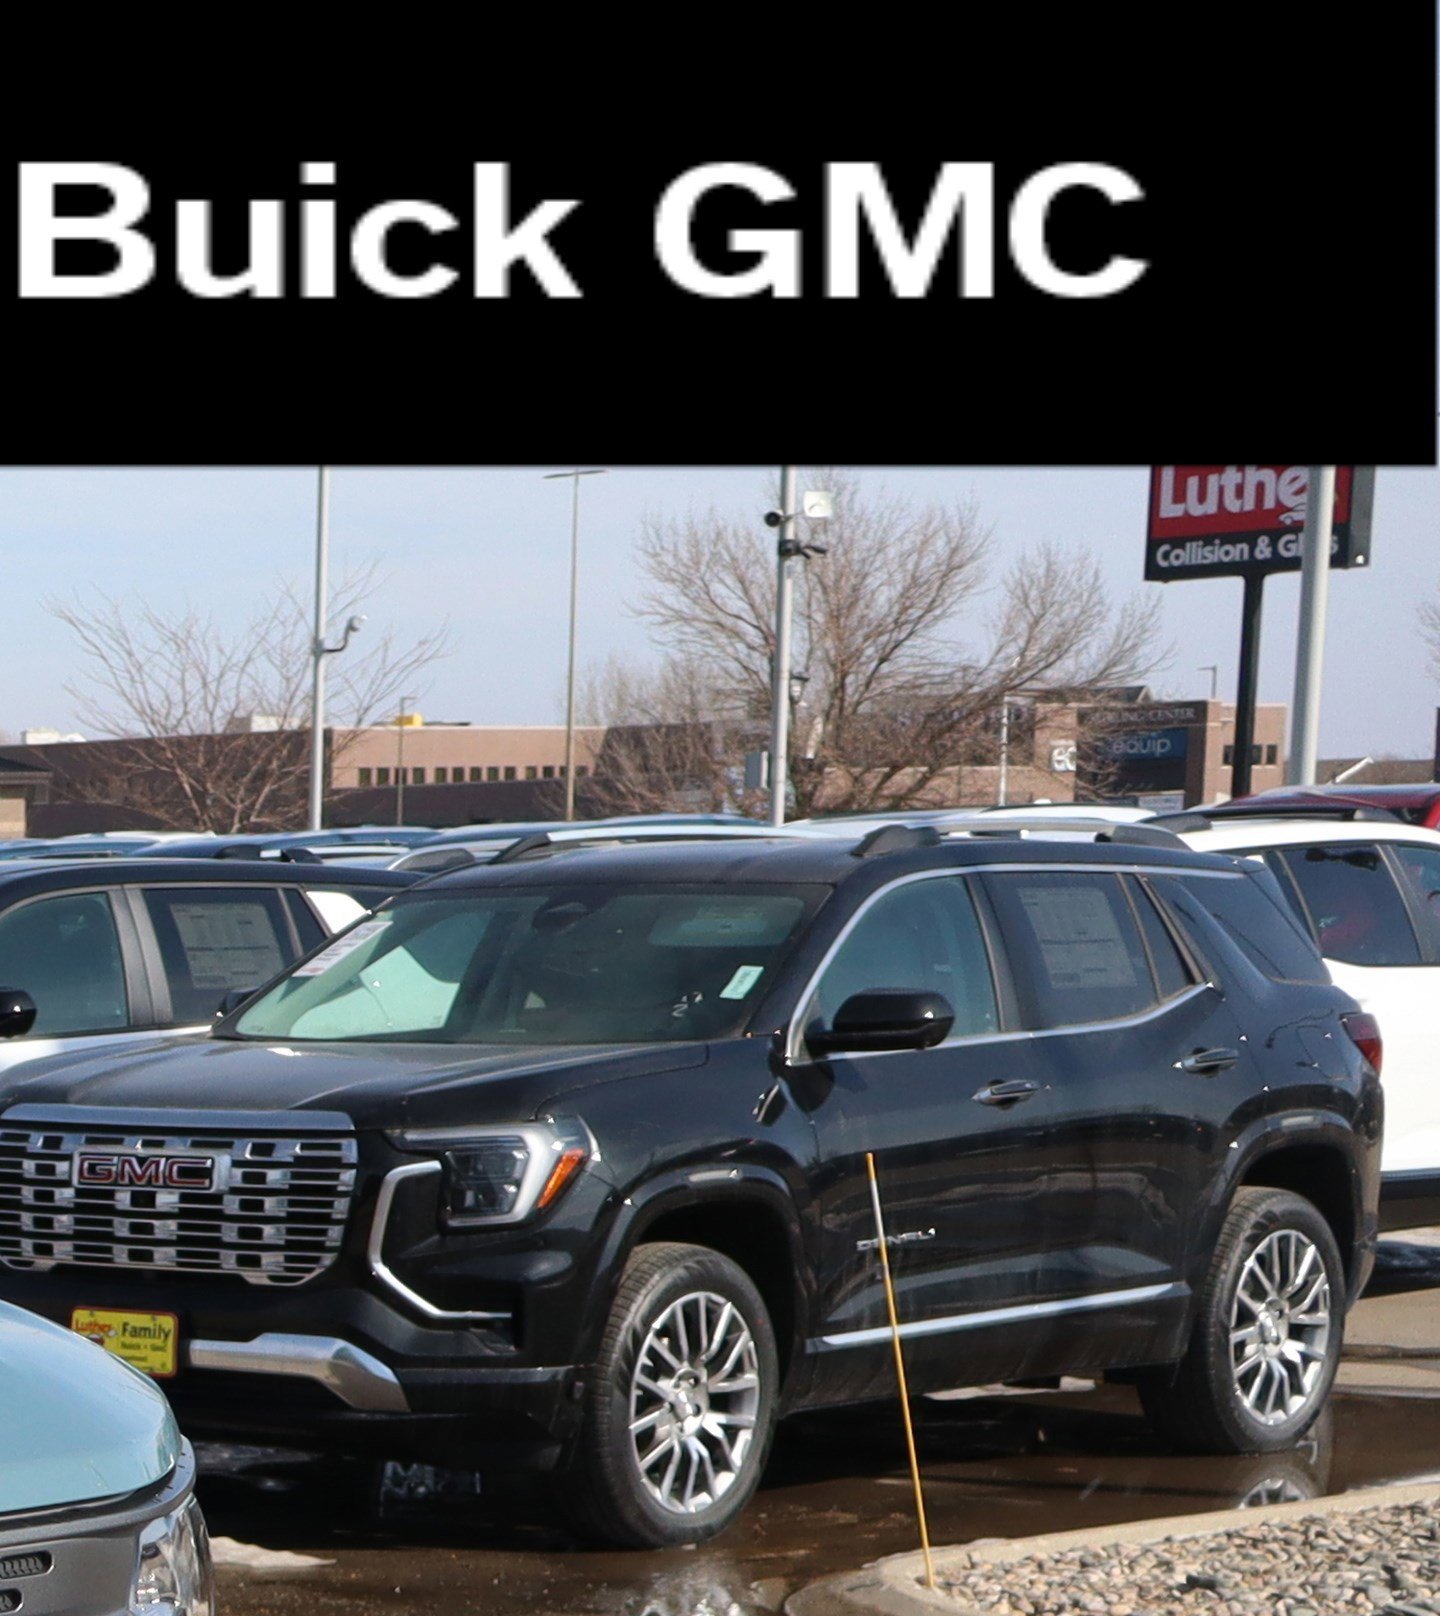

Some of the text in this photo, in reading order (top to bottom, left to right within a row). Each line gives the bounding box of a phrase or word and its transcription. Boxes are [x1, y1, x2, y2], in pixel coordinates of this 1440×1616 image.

[1158, 465, 1310, 519] Luthe
[1156, 533, 1340, 568] Collision & Gls
[1112, 732, 1172, 757] equip
[79, 1154, 213, 1187] GMC
[121, 1322, 171, 1343] Family
